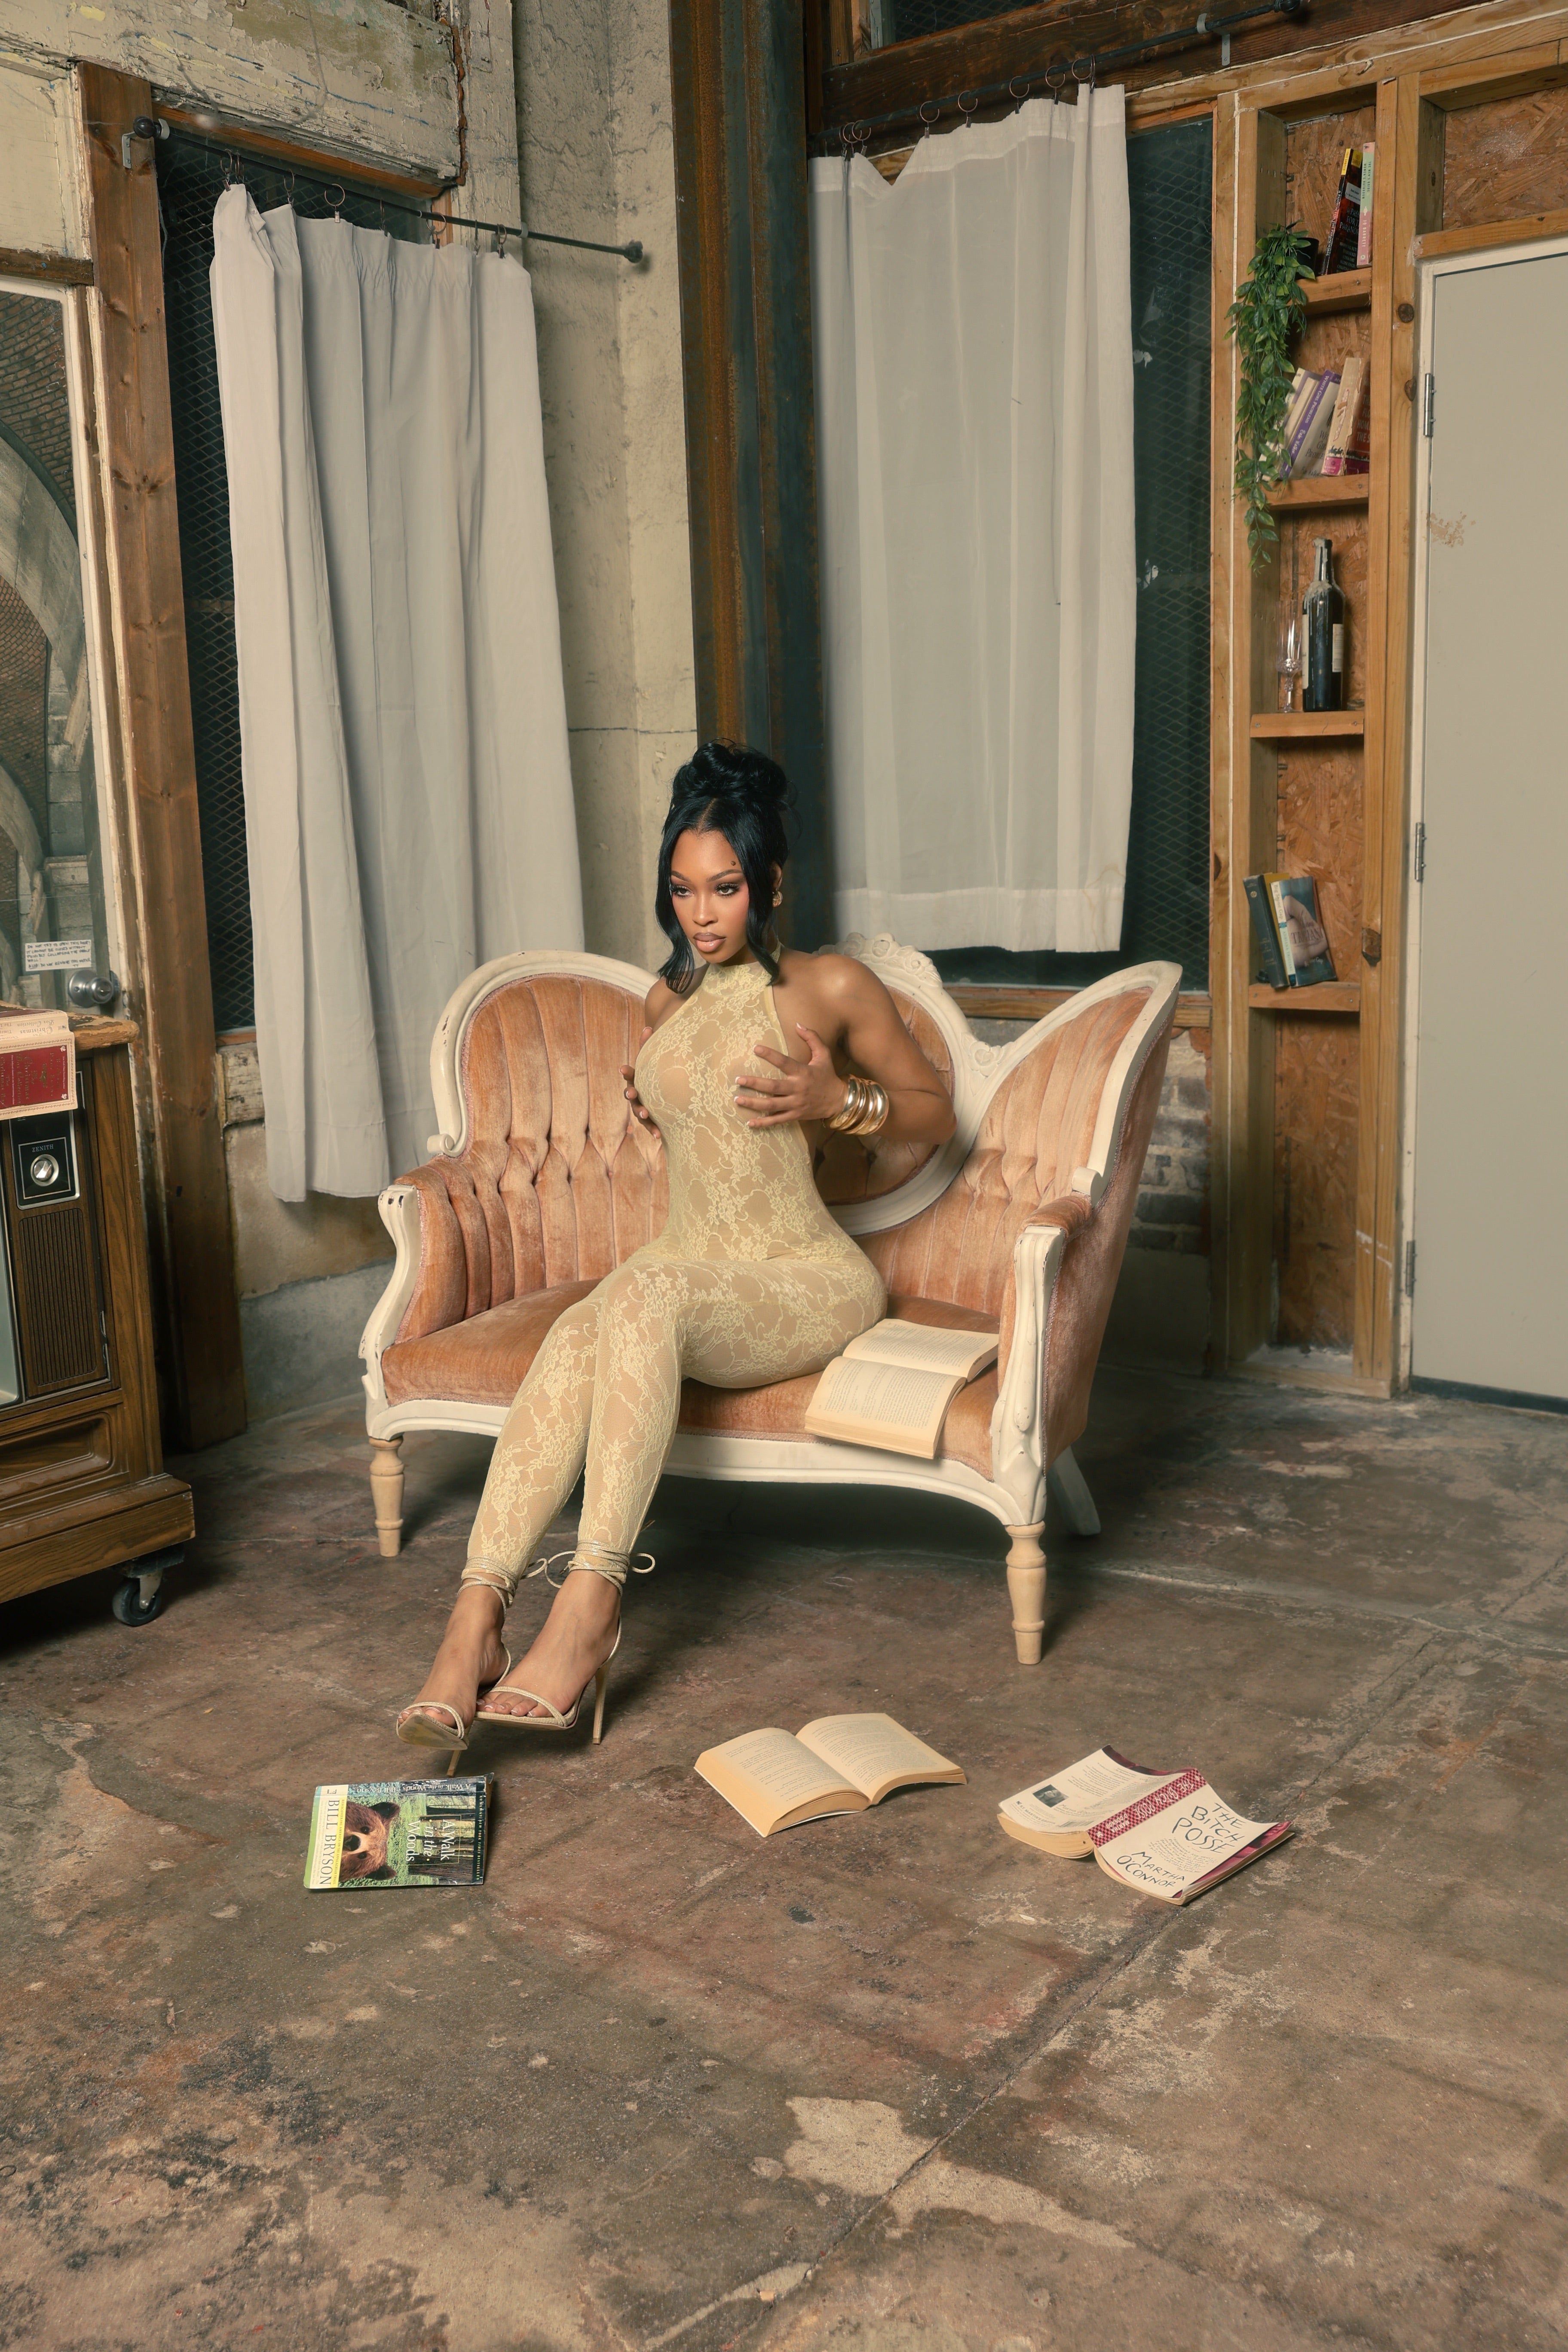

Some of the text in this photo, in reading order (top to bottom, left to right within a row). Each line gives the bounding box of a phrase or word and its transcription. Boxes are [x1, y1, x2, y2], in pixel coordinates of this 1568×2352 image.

[1340, 222, 1359, 234] PARANO
[1347, 216, 1355, 225] FOR
[1357, 431, 1366, 442] THE
[20, 1026, 53, 1034] Christmas
[32, 1144, 54, 1152] ZENITH
[1177, 1778, 1194, 1793] THE
[1155, 1786, 1179, 1806] BITCH
[1133, 1798, 1156, 1819] POSSE
[1212, 1802, 1246, 1829] THE
[1106, 1813, 1128, 1830] O'CONNOR
[1111, 1819, 1130, 1833] MARTHA
[1191, 1805, 1245, 1842] BITCH
[320, 1799, 340, 1886] BILL BRYSON
[405, 1820, 421, 1862] Woods
[440, 1819, 455, 1861] A Walk
[1172, 1817, 1235, 1854] POSSE
[423, 1840, 437, 1857] the
[1117, 1855, 1176, 1887] O'CONNOR
[1131, 1851, 1185, 1881] MARTHA
